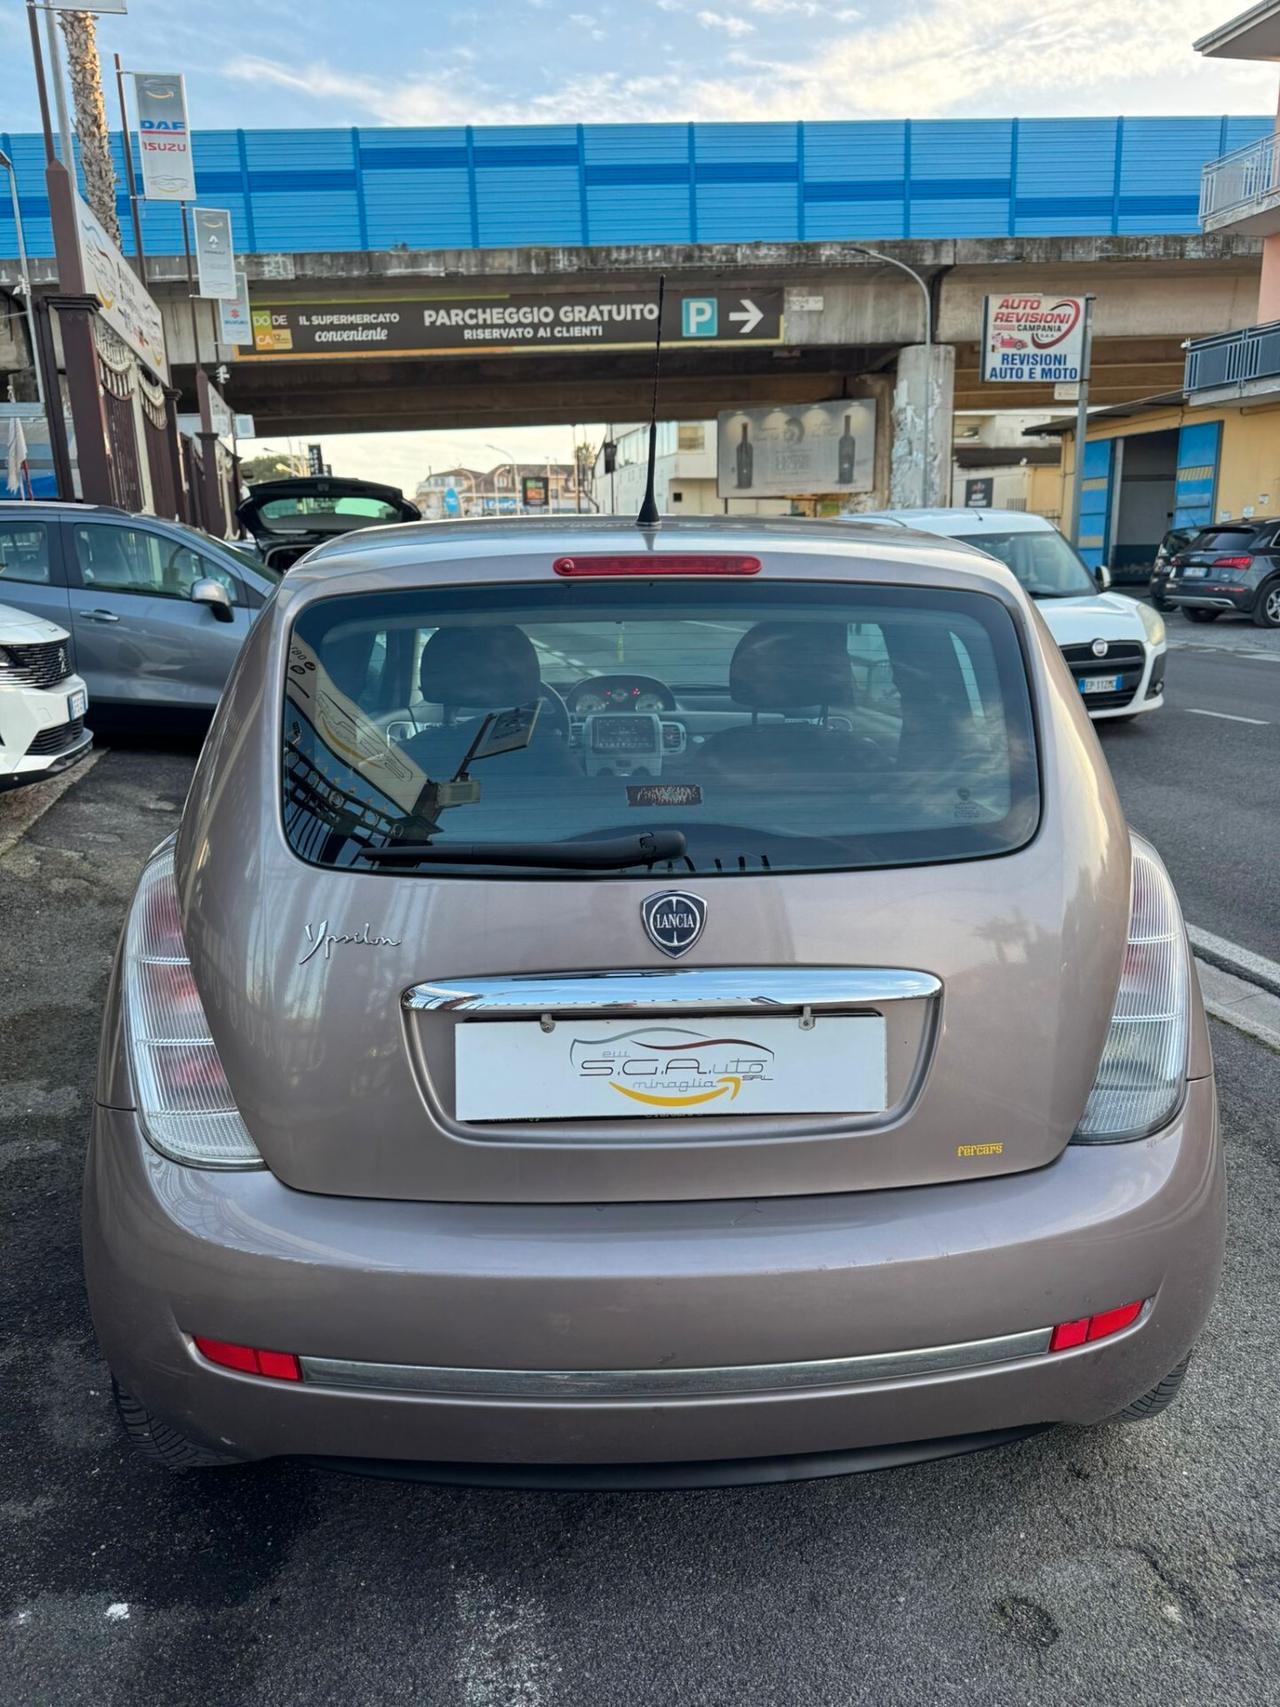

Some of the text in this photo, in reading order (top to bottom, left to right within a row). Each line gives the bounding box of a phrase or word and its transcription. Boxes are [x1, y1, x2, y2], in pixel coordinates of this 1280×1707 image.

[140, 120, 186, 130] DAF
[143, 142, 187, 152] ISUZU
[999, 299, 1041, 310] AUTO
[253, 315, 271, 326] DO
[272, 314, 288, 326] DE
[299, 312, 400, 326] IL SUPERMERCATO
[423, 304, 660, 327] PARCHEGGIO GRATUITO
[689, 301, 713, 333] P
[994, 312, 1071, 324] REVISIONI
[257, 335, 274, 345] CA
[315, 326, 388, 343] conveniente
[463, 325, 603, 341] RISERVATO AI CLIENTI
[1001, 353, 1067, 367] REVISIONI
[989, 367, 1078, 381] AUTO E MOTO
[656, 913, 694, 929] LANCIA
[299, 920, 401, 965] Ypsilon
